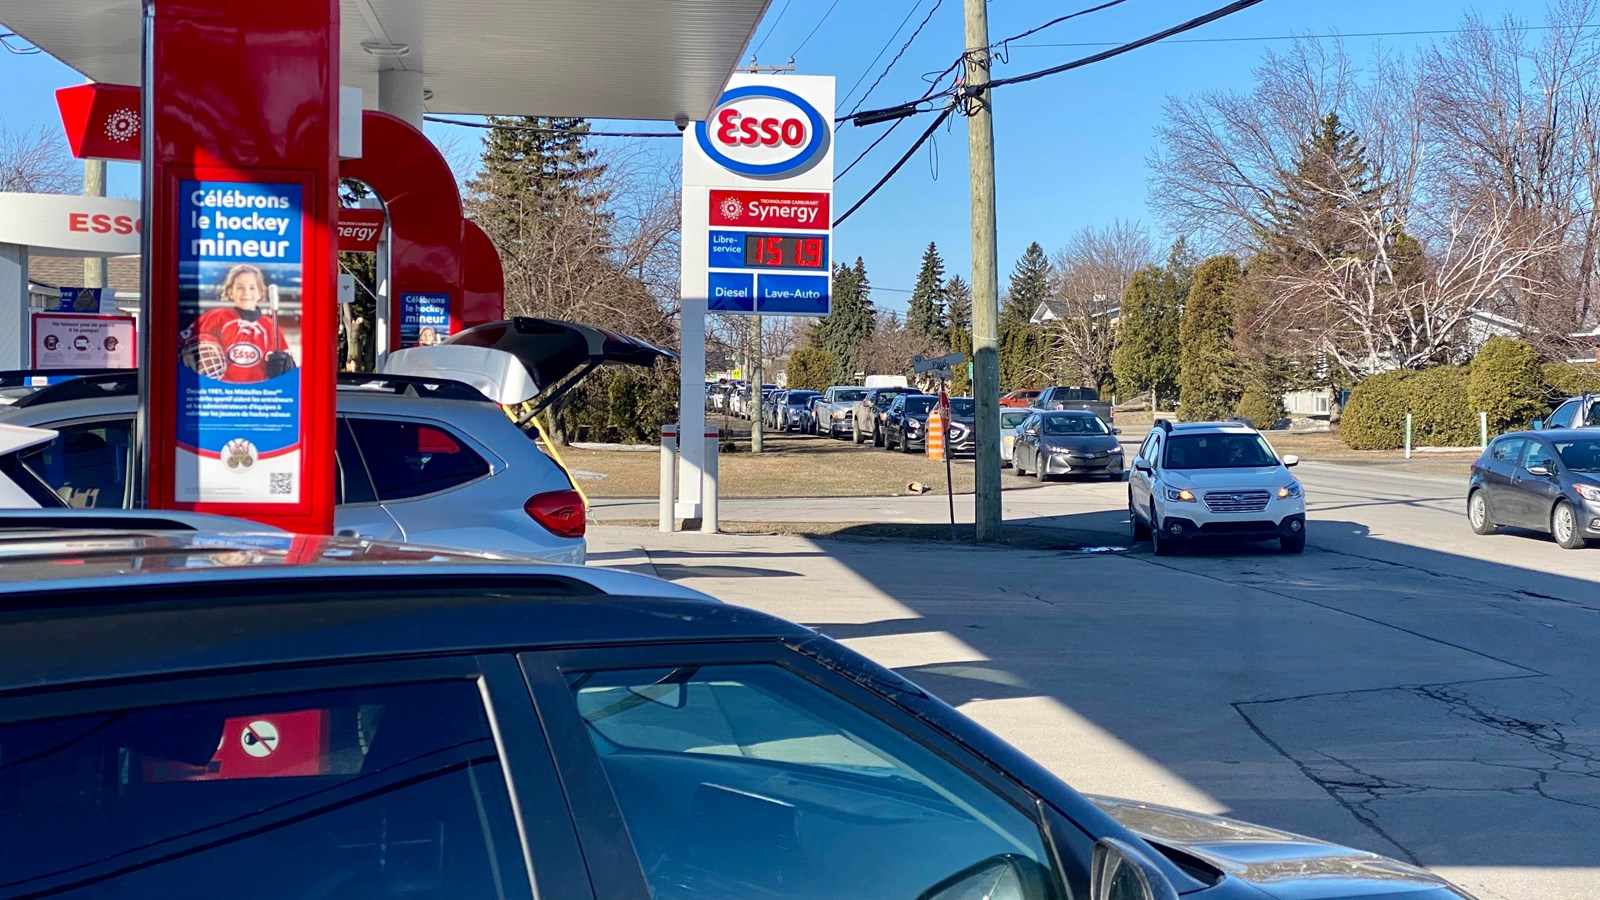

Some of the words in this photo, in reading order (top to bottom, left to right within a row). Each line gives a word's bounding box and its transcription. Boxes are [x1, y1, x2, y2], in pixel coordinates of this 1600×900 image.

[717, 108, 805, 147] Esso
[191, 190, 290, 209] Célébrons
[748, 201, 819, 223] Synergy
[191, 210, 211, 230] le
[215, 210, 290, 236] hockey
[191, 232, 290, 258] mineur
[713, 235, 738, 244] Libre-
[713, 245, 742, 253] service
[715, 287, 748, 298] Diesel
[765, 288, 820, 299] Lave-Auto
[415, 304, 445, 315] hockey
[406, 313, 445, 323] mineur
[232, 349, 256, 359] Esso
